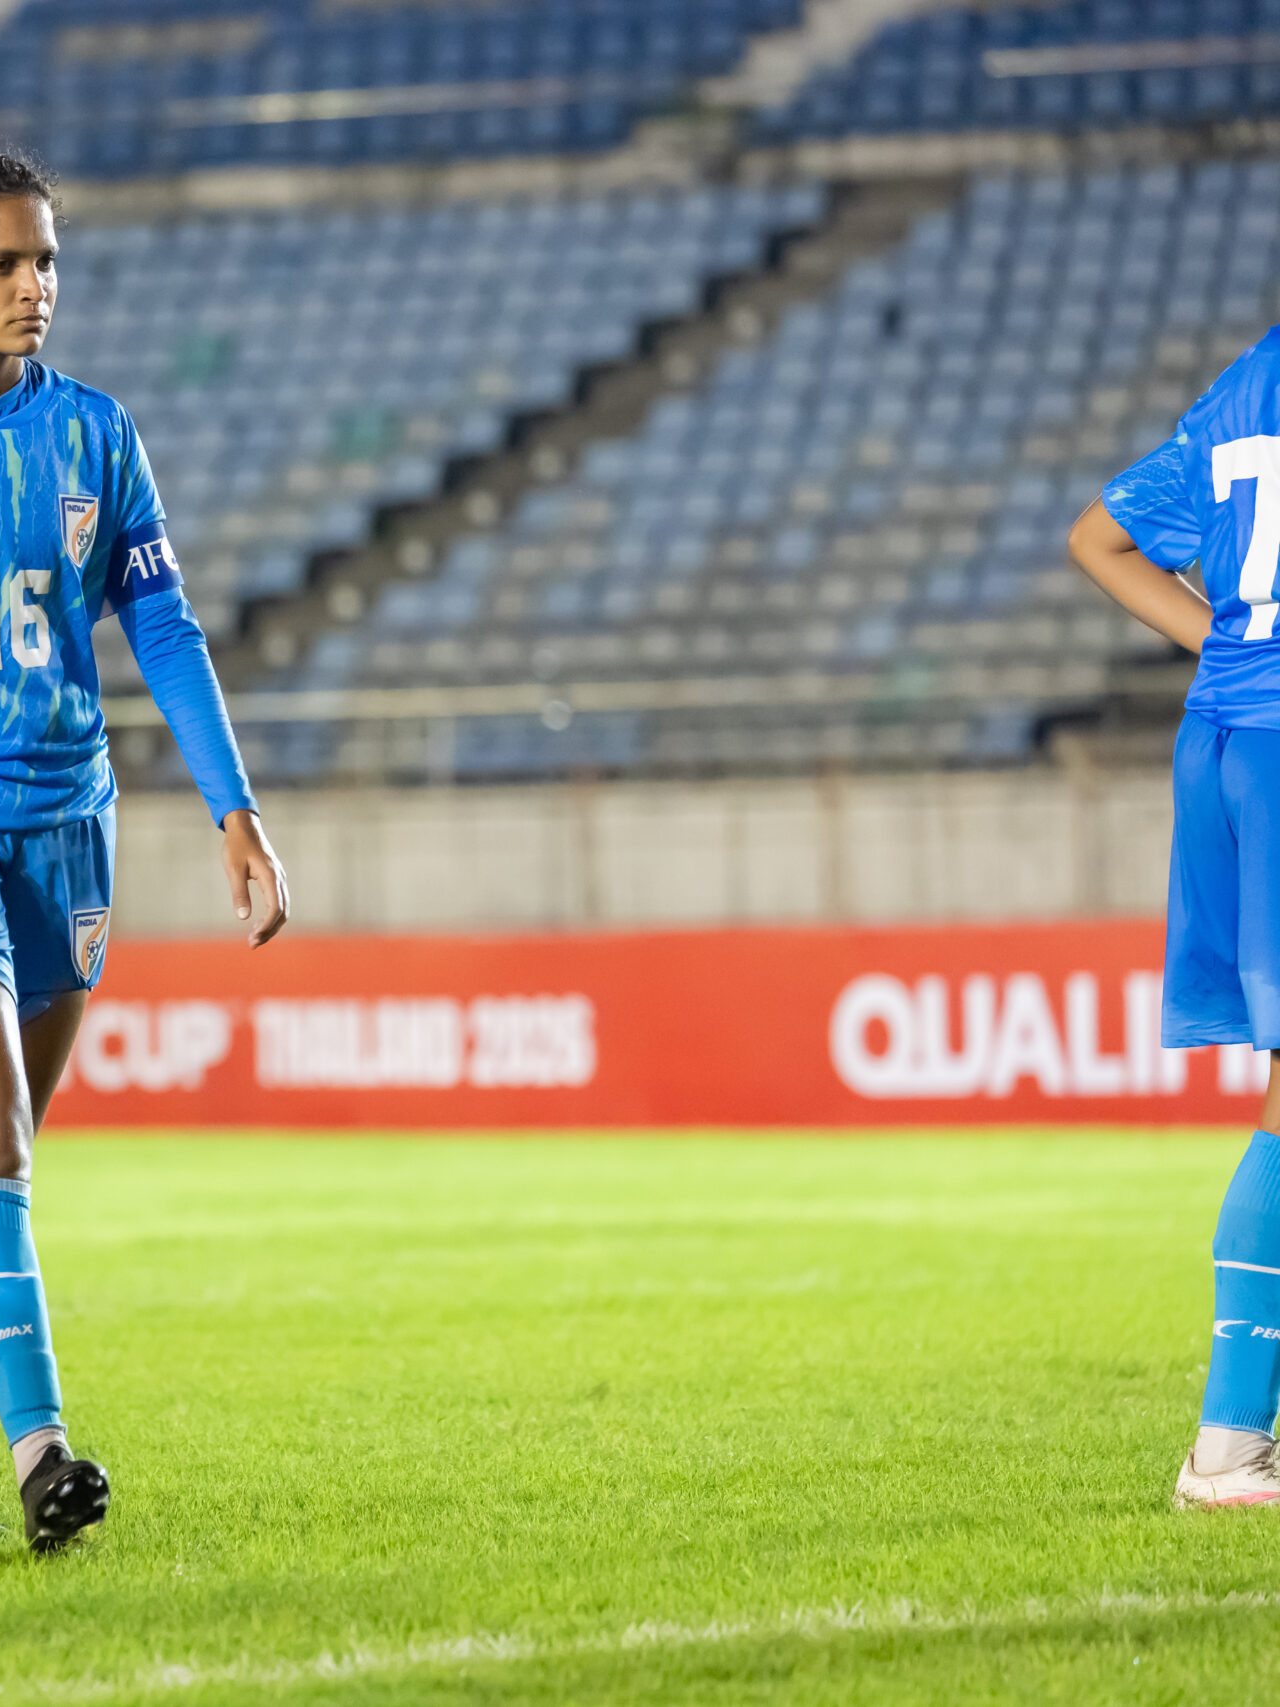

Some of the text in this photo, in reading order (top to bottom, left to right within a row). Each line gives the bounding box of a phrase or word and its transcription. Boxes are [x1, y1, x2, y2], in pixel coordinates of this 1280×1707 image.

[66, 504, 86, 513] INDIA
[78, 918, 97, 927] INDIA
[76, 1001, 232, 1092] CUP
[253, 996, 465, 1090] THAILAND
